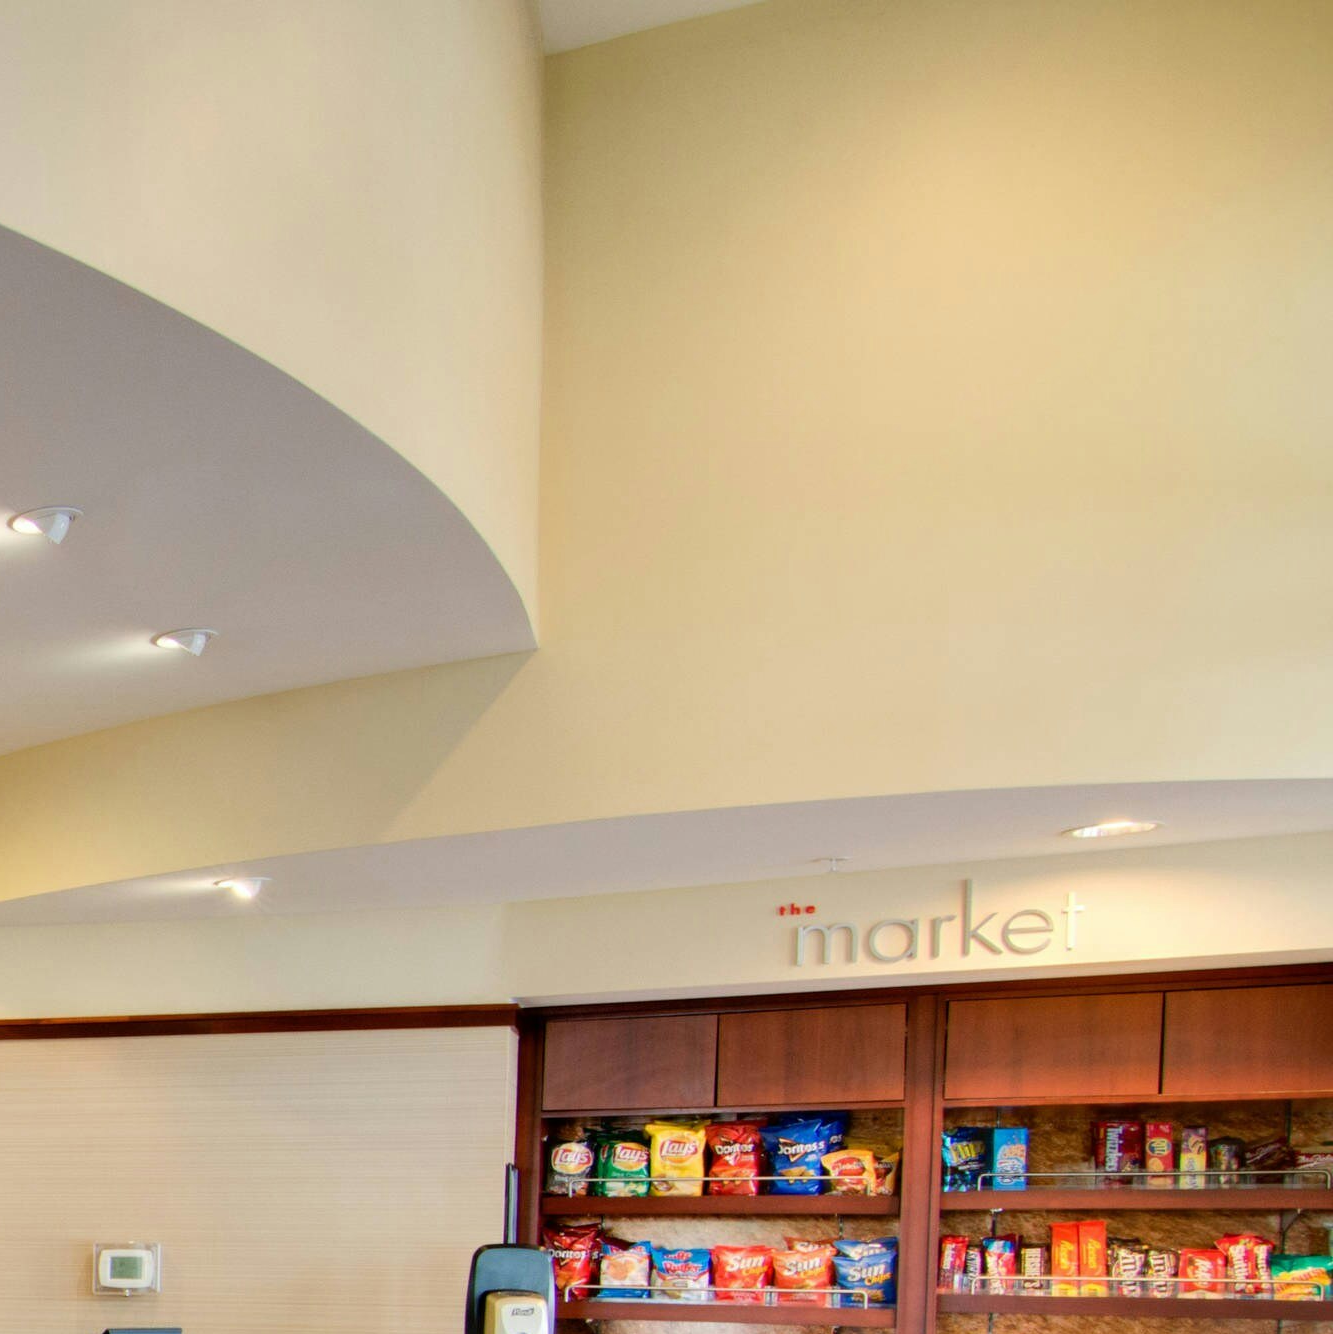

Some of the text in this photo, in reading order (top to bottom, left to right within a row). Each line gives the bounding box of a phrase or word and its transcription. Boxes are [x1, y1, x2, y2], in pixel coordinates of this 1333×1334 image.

[778, 903, 816, 916] the
[793, 879, 1086, 967] market
[727, 1256, 764, 1272] Sun
[784, 1257, 821, 1276] Sun
[847, 1264, 885, 1282] Sun
[1025, 1248, 1041, 1289] HERSHE'S
